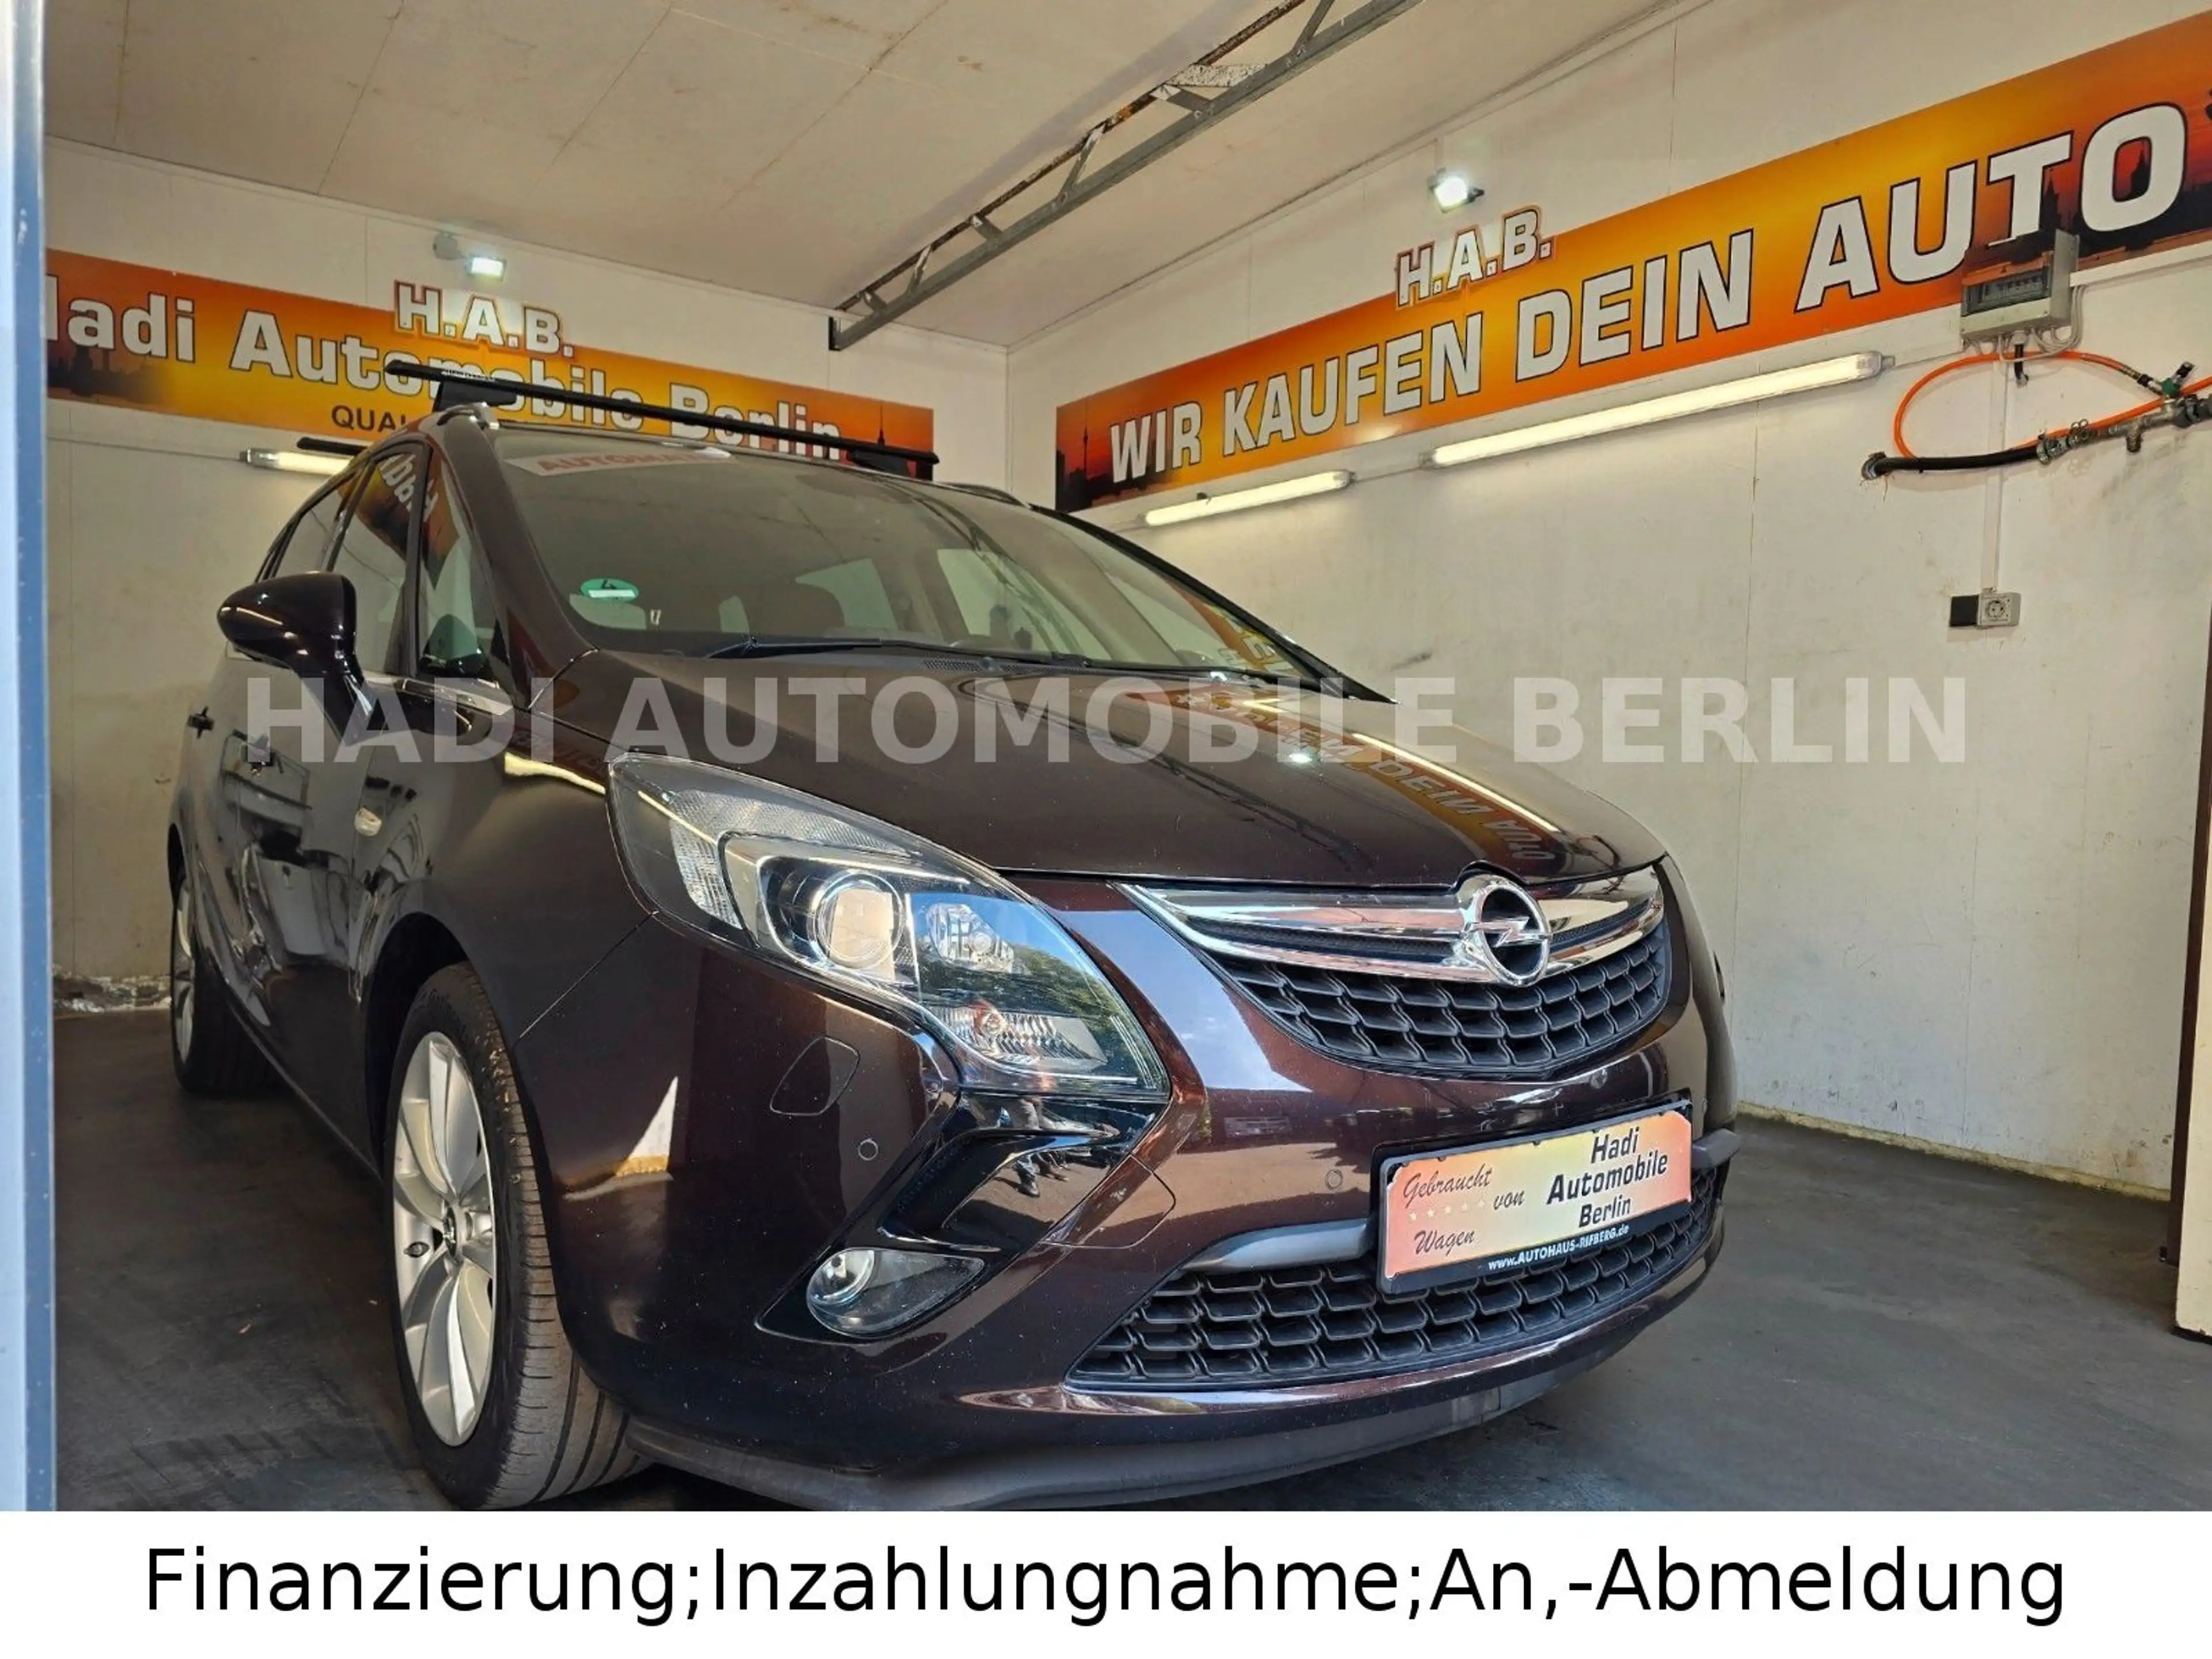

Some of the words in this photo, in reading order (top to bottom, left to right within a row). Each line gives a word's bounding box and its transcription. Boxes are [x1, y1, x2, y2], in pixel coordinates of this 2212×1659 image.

[1396, 208, 1553, 308] H.A.B.
[1108, 400, 1203, 484] WIR
[1222, 311, 1484, 456] KAUFEN
[1515, 228, 1755, 383] DEIN
[1793, 101, 2188, 313] AUTO
[395, 281, 575, 358] H.A.B.
[669, 382, 842, 461] Berlin
[1590, 1126, 1640, 1164] Hadi
[1403, 1162, 1493, 1209] Gebraucht
[1493, 1190, 1525, 1211] von
[1546, 1152, 1668, 1206] Automobile
[1578, 1196, 1631, 1228] Berlin
[1413, 1229, 1476, 1256] Wagen
